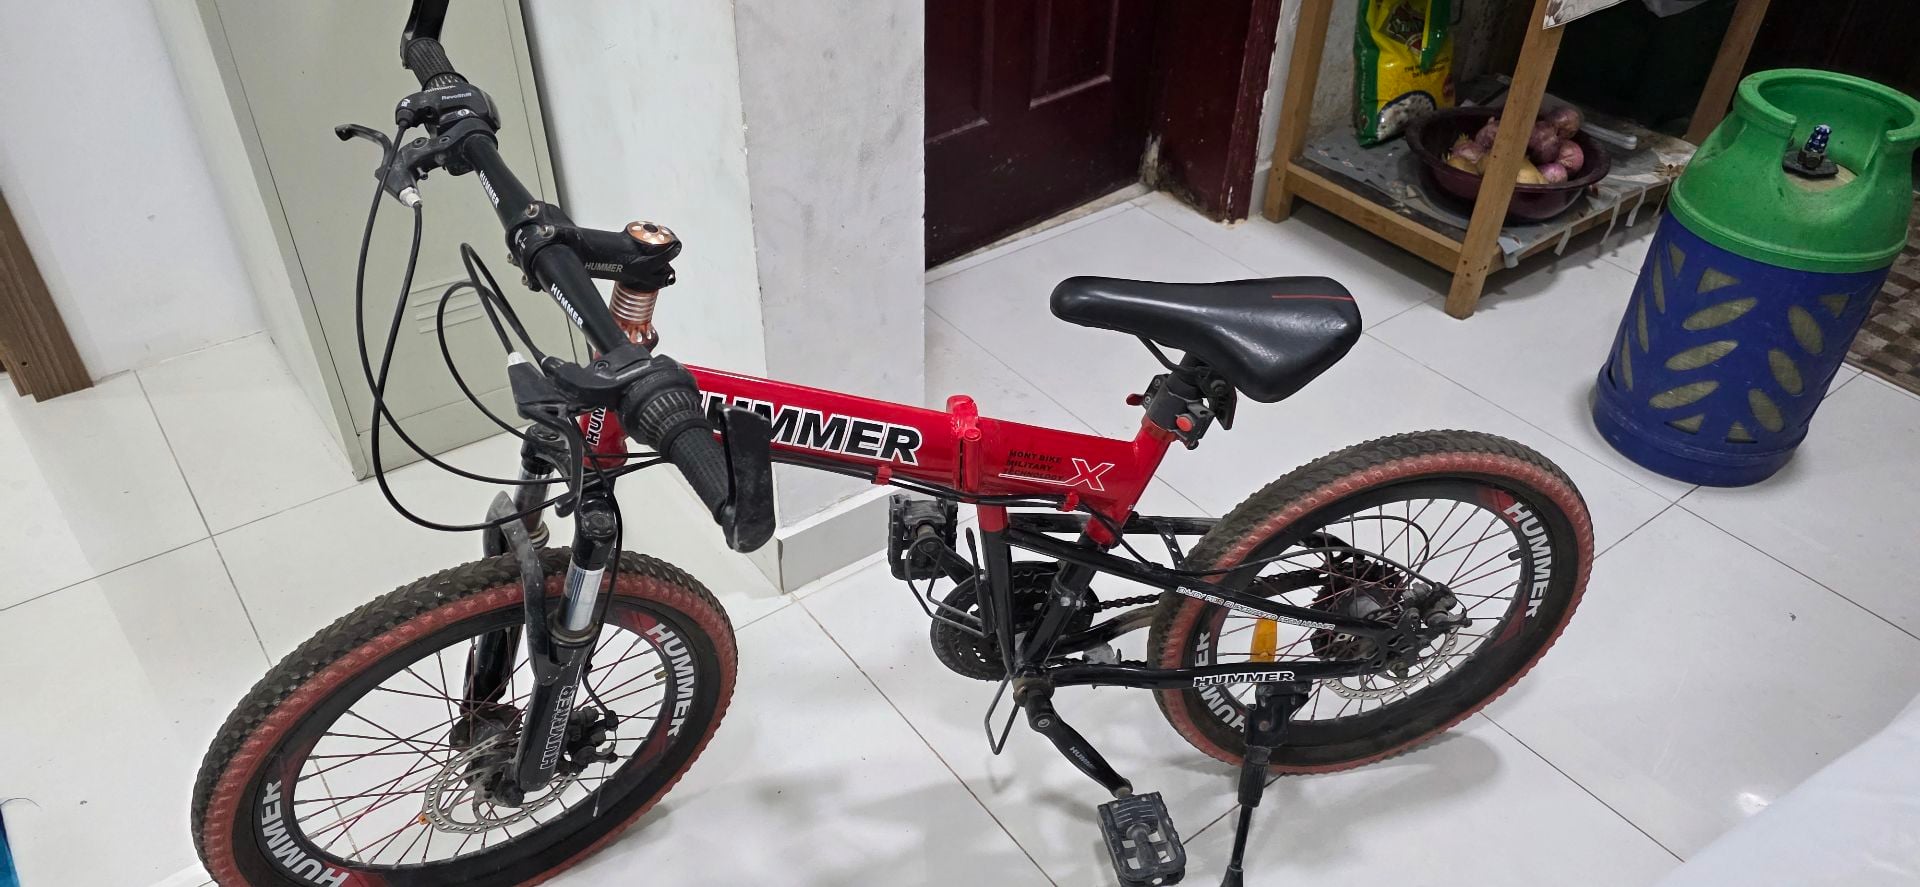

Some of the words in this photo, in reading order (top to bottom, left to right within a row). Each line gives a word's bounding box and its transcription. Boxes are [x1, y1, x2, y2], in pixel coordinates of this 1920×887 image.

[479, 170, 500, 208] HUMMER
[584, 262, 624, 273] HUMMER
[550, 283, 584, 329] HUMMER
[698, 390, 923, 466] UMMER
[1006, 460, 1053, 472] MILITARY
[1040, 455, 1063, 464] BIKE
[1503, 501, 1552, 618] HUMMER
[645, 623, 695, 737] HUMMER
[1193, 670, 1295, 688] HUMMER
[1195, 631, 1246, 733] HUMER
[540, 685, 578, 770] HUMMER
[261, 780, 350, 887] HUMMER
